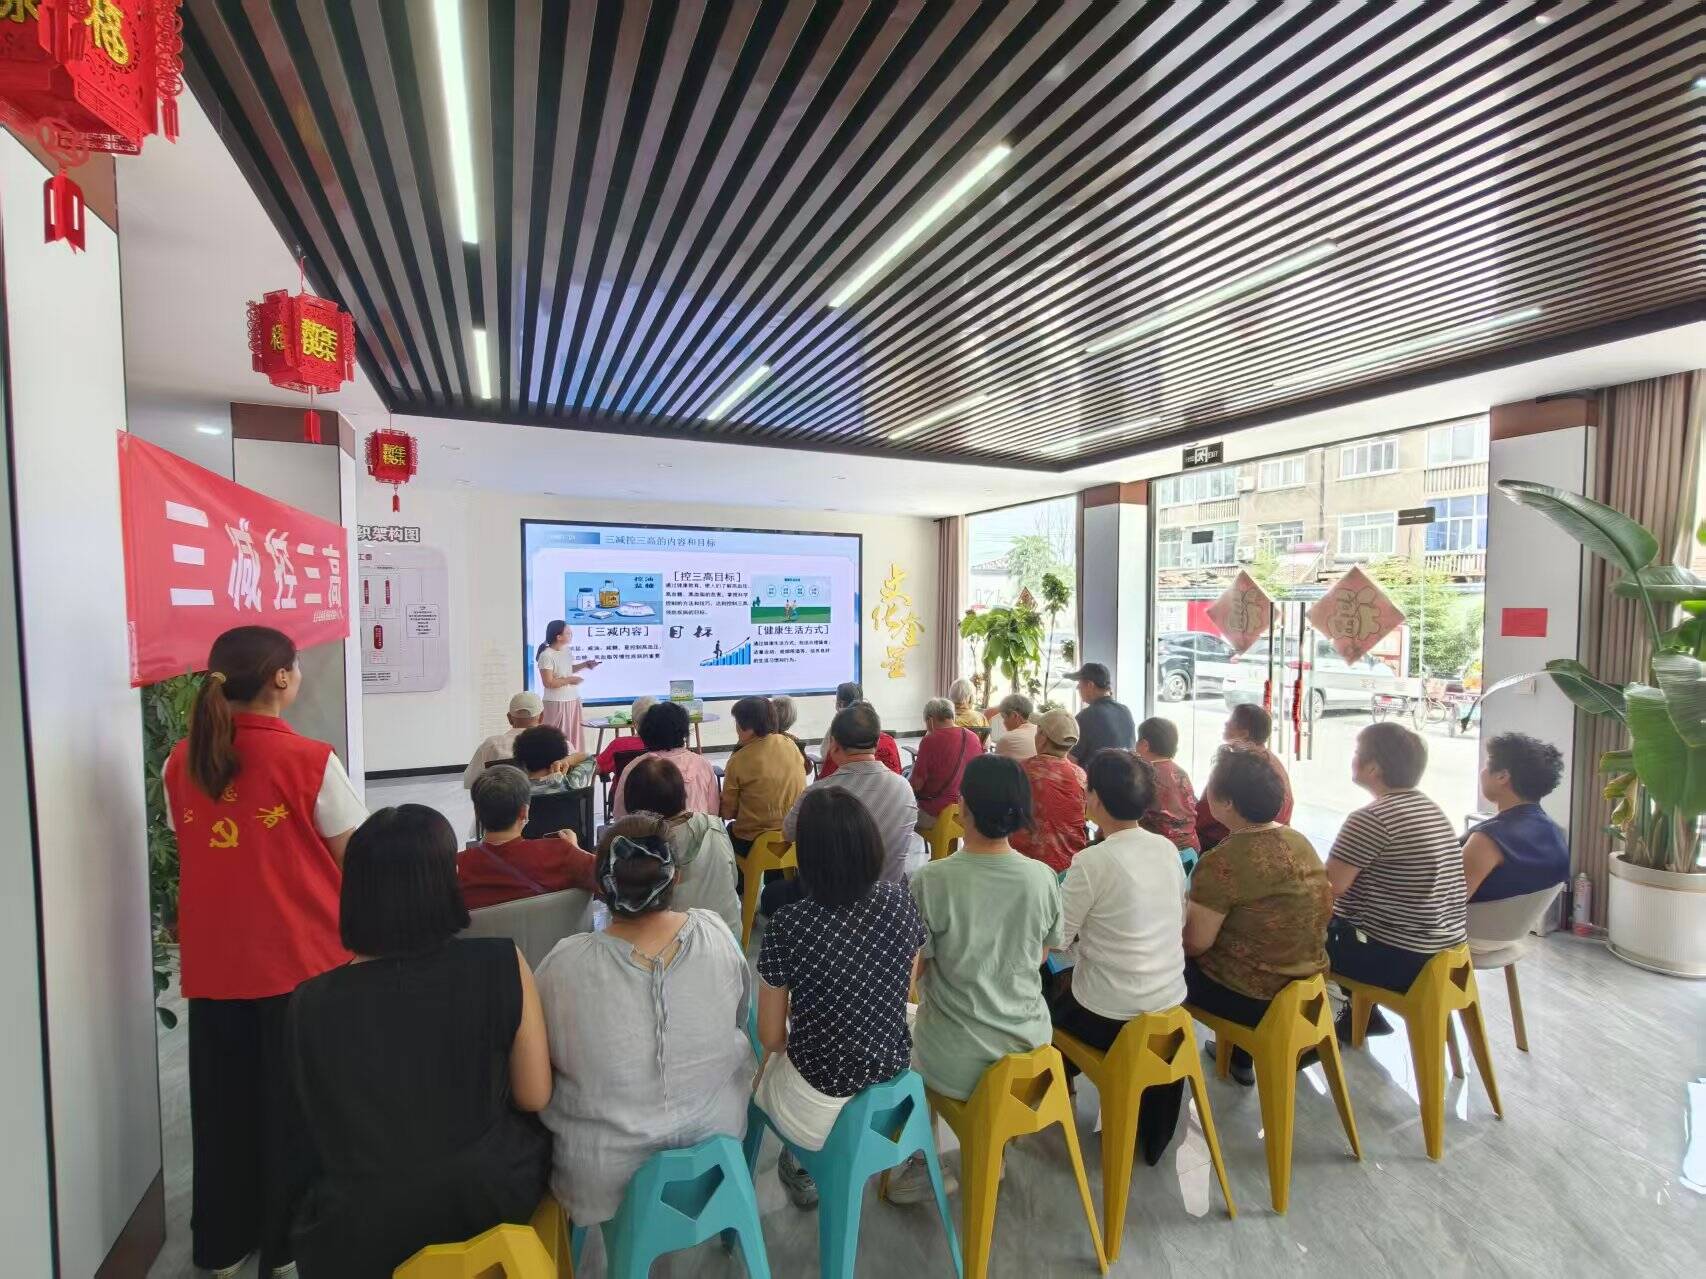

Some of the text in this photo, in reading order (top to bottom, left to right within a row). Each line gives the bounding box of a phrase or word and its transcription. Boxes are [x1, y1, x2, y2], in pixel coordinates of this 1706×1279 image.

[605, 534, 717, 548] 三减控三高的内容和目标
